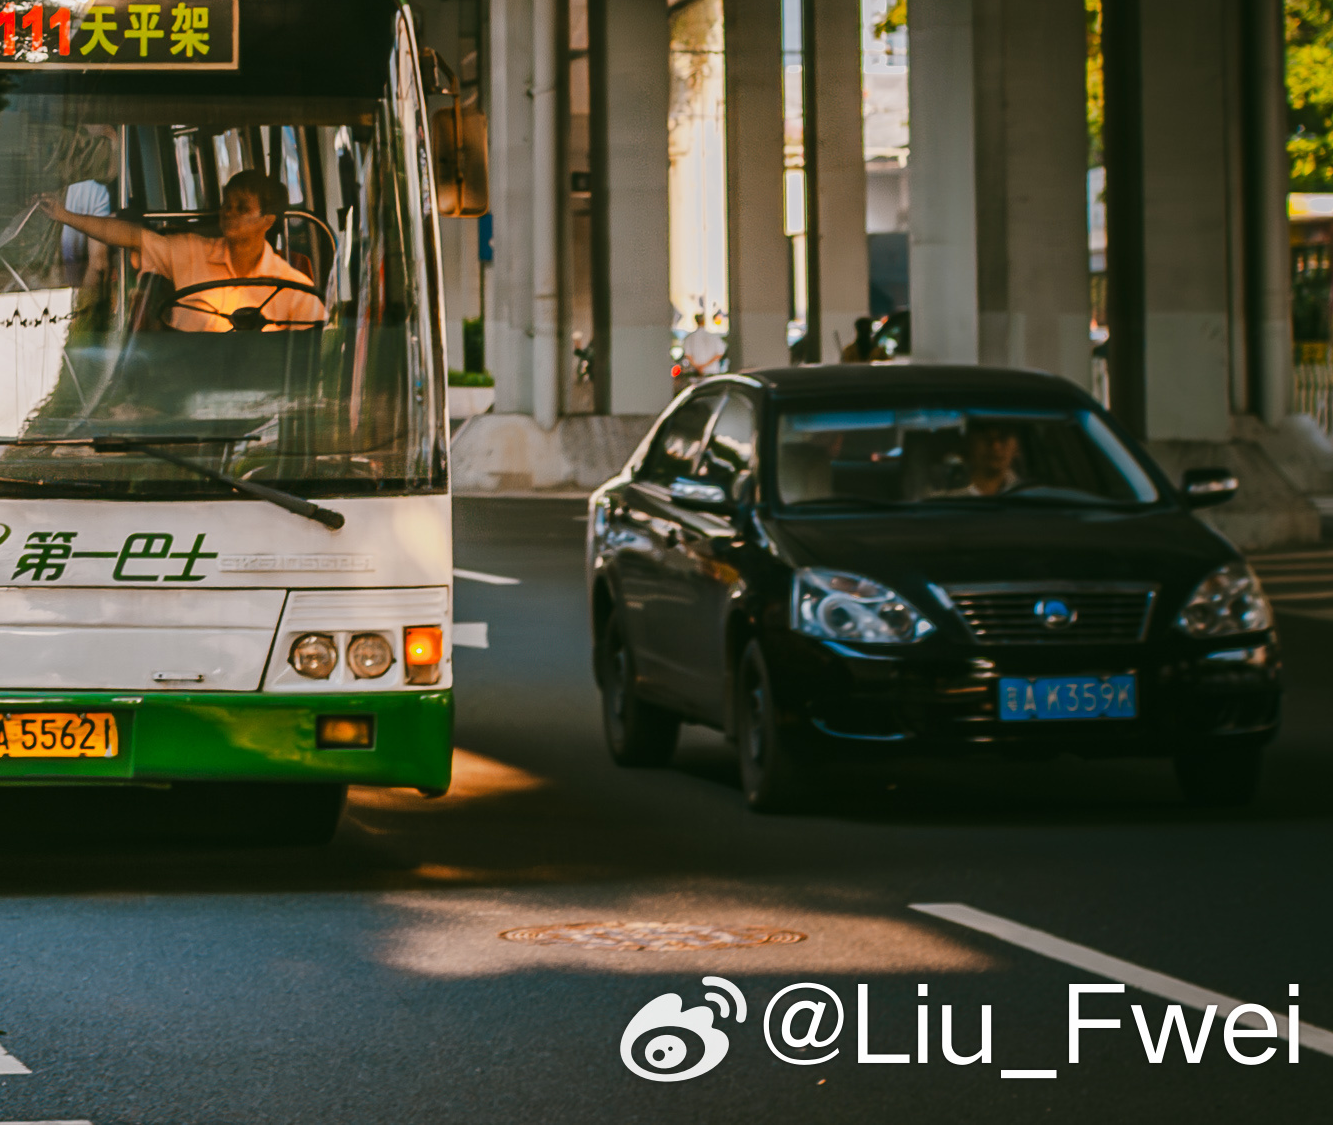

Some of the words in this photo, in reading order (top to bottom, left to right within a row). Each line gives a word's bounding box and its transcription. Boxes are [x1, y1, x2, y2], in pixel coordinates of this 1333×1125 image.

[79, 2, 211, 57] 天平架
[11, 531, 219, 582] 第一巴士
